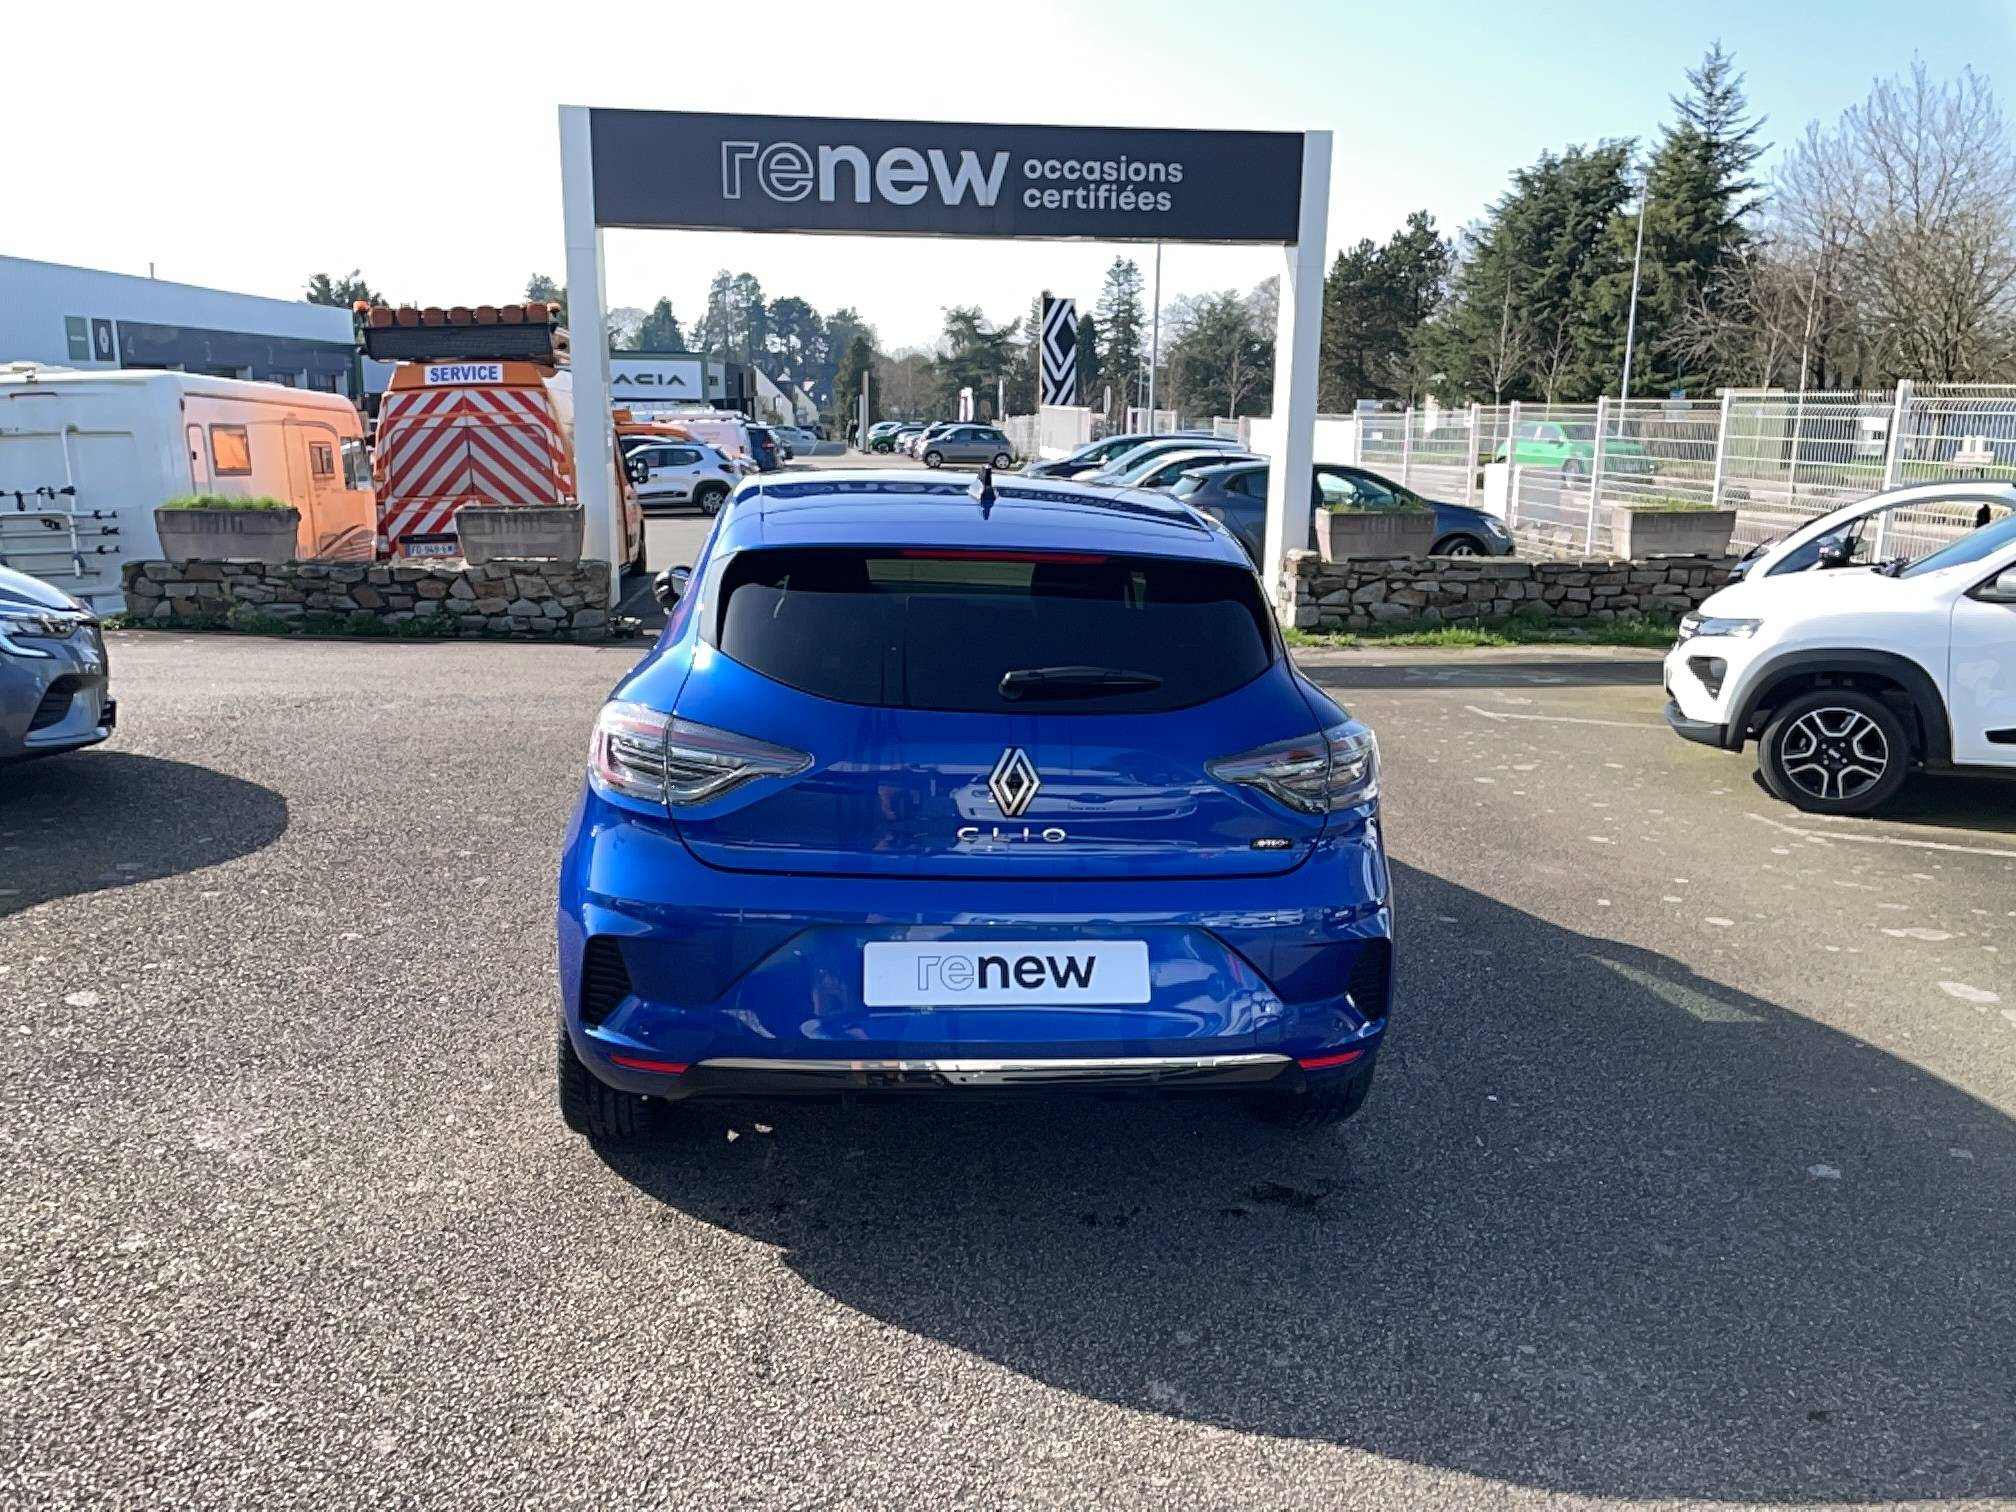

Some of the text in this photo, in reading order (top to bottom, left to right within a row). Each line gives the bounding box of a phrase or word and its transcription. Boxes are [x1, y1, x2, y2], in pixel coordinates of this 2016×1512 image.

[720, 140, 1011, 207] renew
[1023, 155, 1184, 183] occasions
[1023, 183, 1172, 212] certifiées
[430, 366, 498, 382] SERVICE
[612, 373, 687, 386] ACIA
[957, 827, 1066, 842] CLIO
[917, 954, 1097, 992] renew
